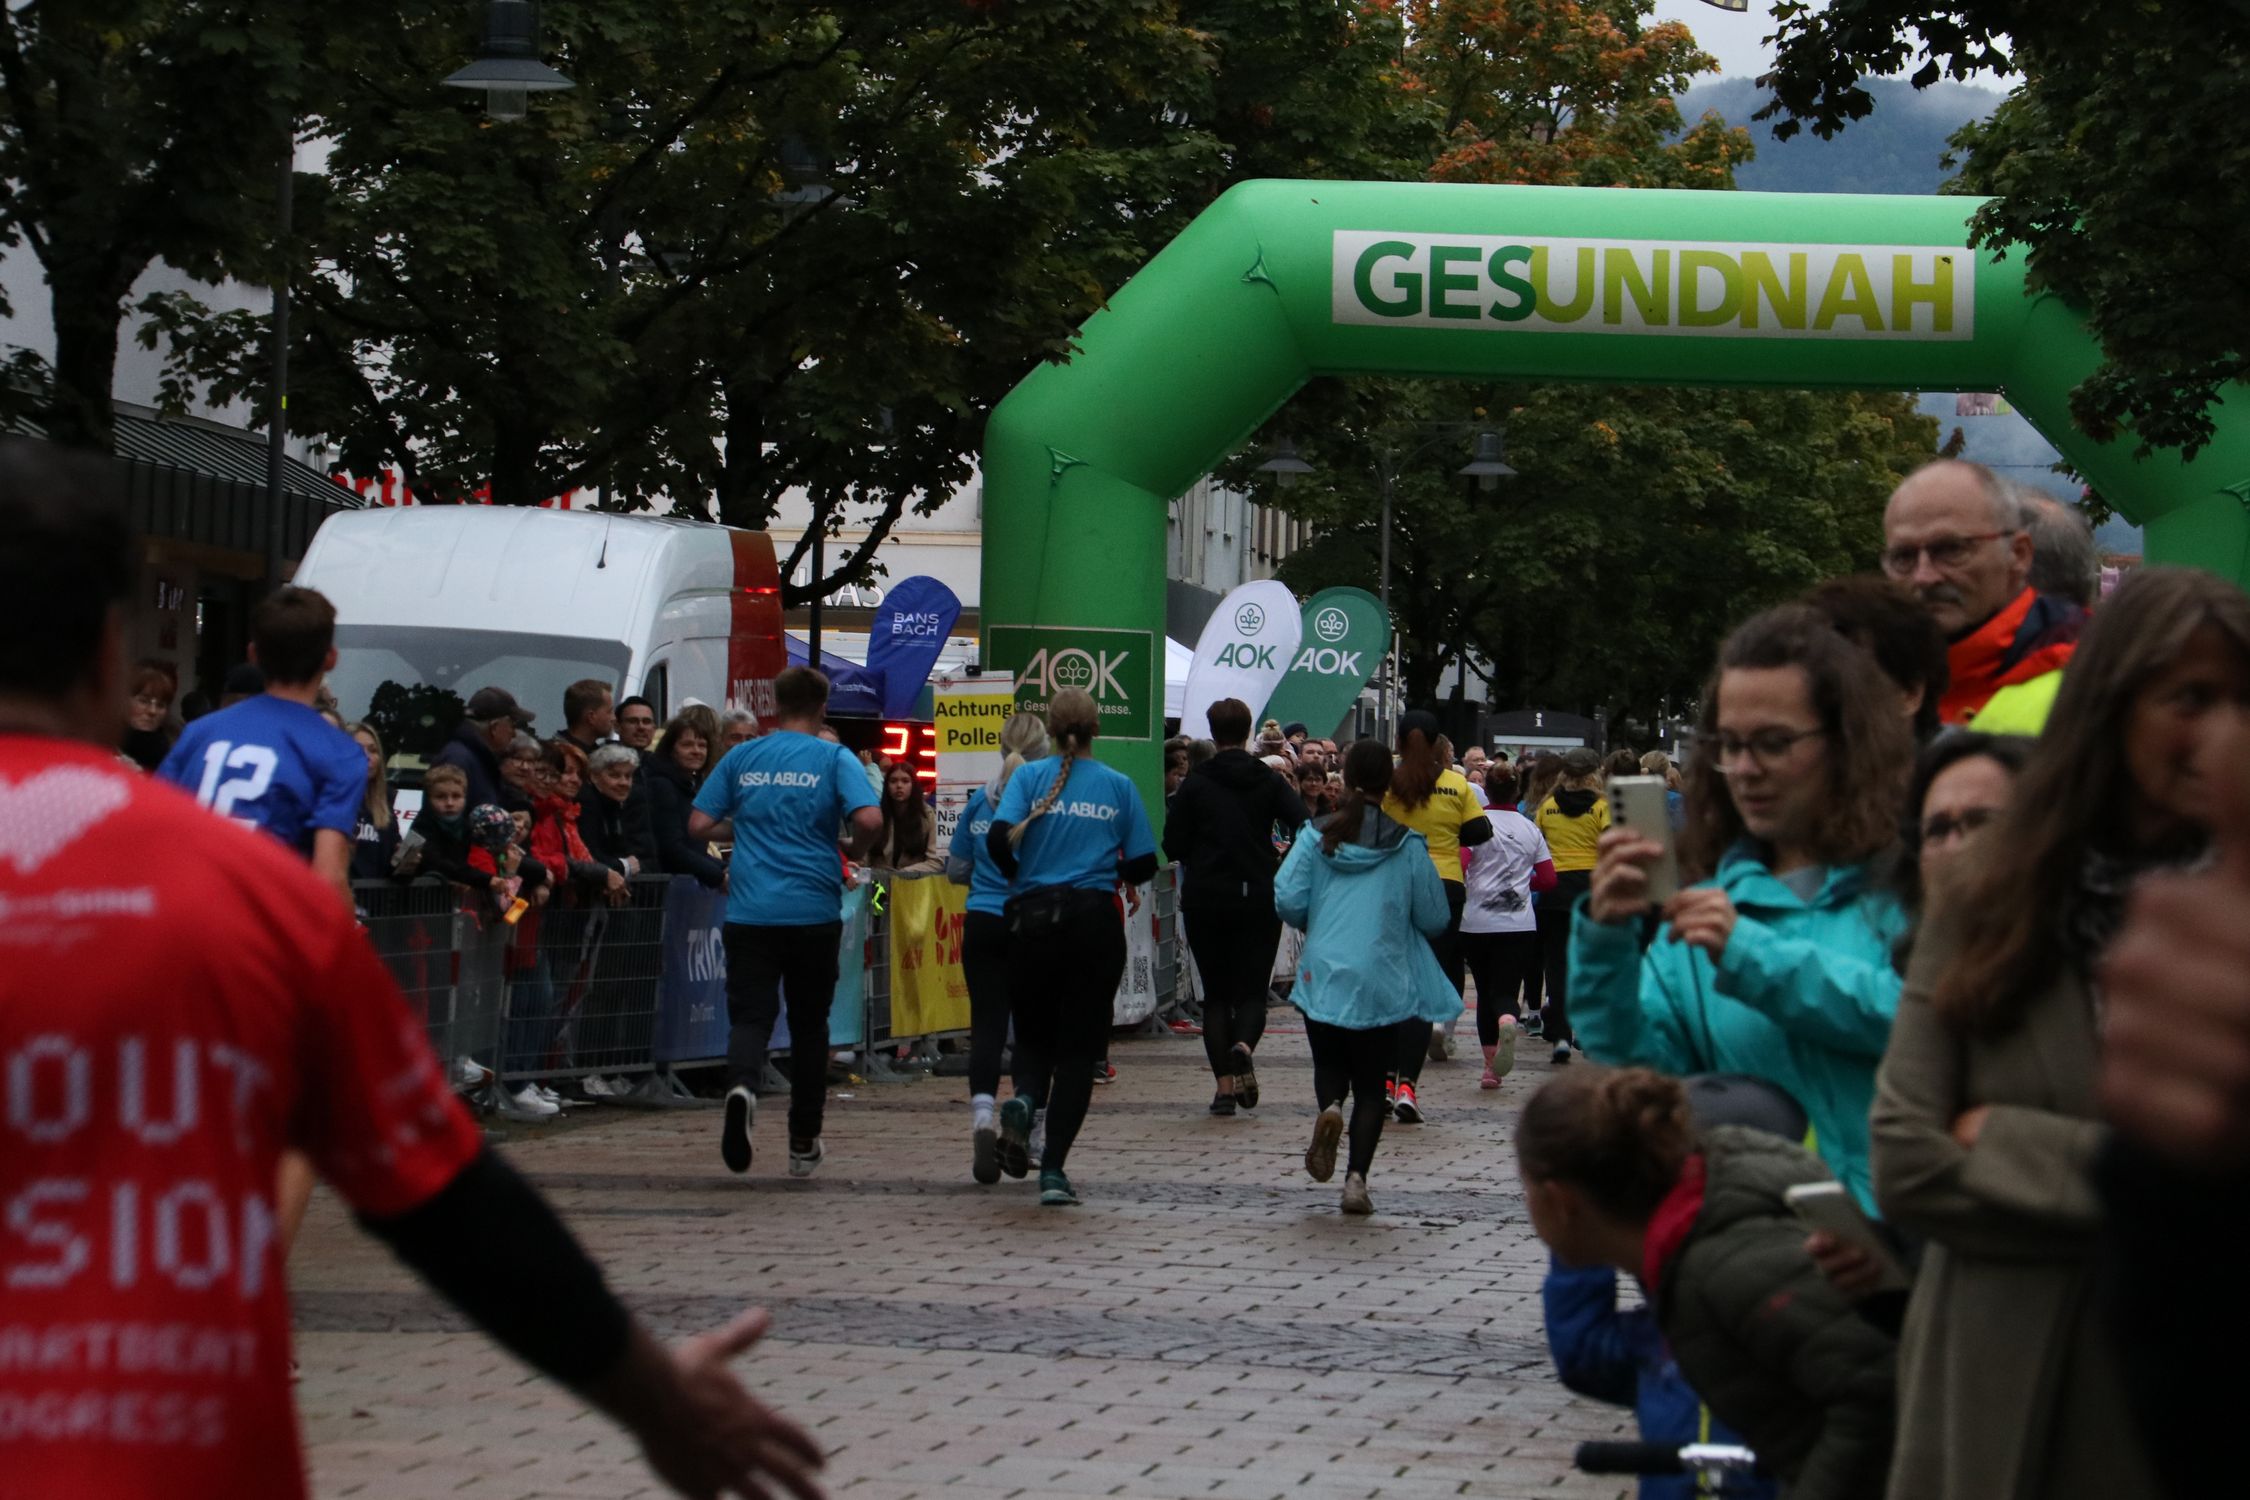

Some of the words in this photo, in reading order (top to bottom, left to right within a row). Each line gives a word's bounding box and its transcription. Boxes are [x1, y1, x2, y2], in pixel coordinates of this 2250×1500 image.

[1353, 240, 1955, 333] GESUNDNAH
[892, 623, 938, 636] BACH
[894, 612, 940, 625] BANS
[1213, 643, 1278, 670] AOK
[1291, 647, 1363, 677] AOK
[1013, 648, 1130, 700] AOK
[935, 700, 1013, 719] Achtung
[196, 738, 278, 832] 12
[772, 771, 821, 788] ABLOY
[1067, 800, 1120, 822] ABLOY
